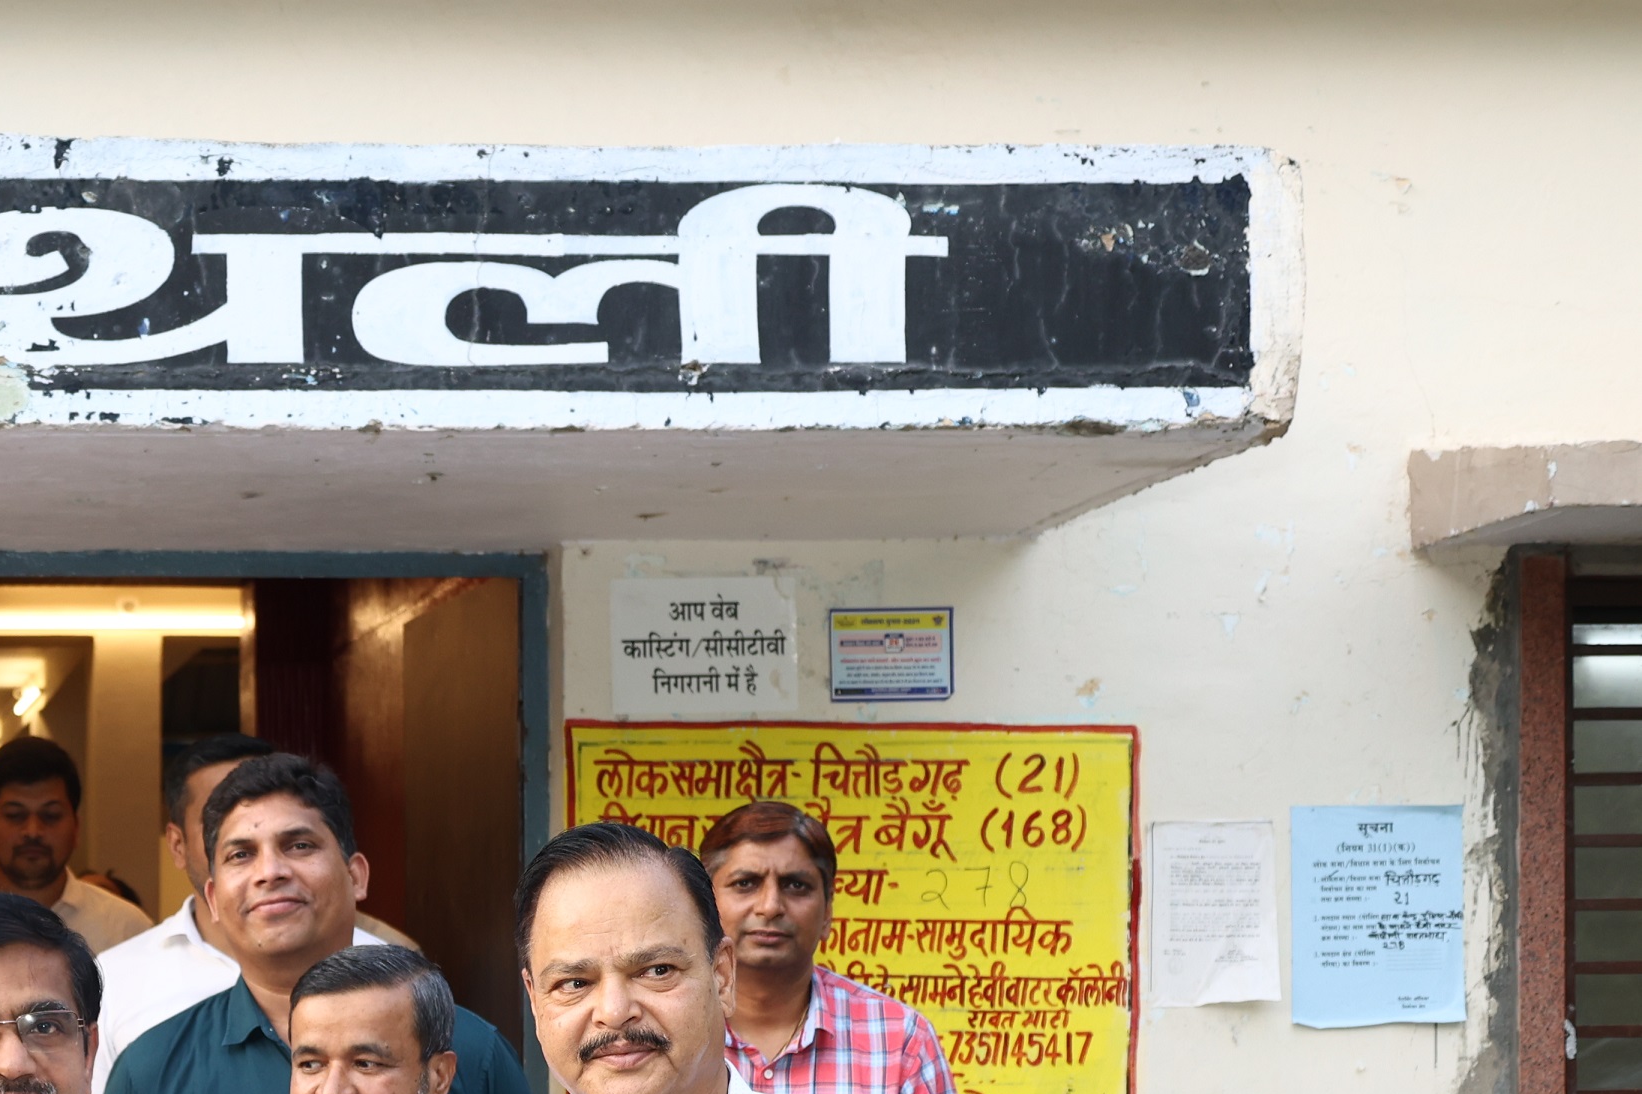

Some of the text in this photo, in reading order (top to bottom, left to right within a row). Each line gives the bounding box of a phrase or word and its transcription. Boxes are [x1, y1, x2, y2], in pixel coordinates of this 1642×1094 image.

[669, 594, 739, 621] आप वेब
[652, 664, 758, 695] निगरानी में है
[996, 752, 1080, 800] (21)
[981, 804, 1087, 852] (168)
[1358, 822, 1394, 838] सूचना
